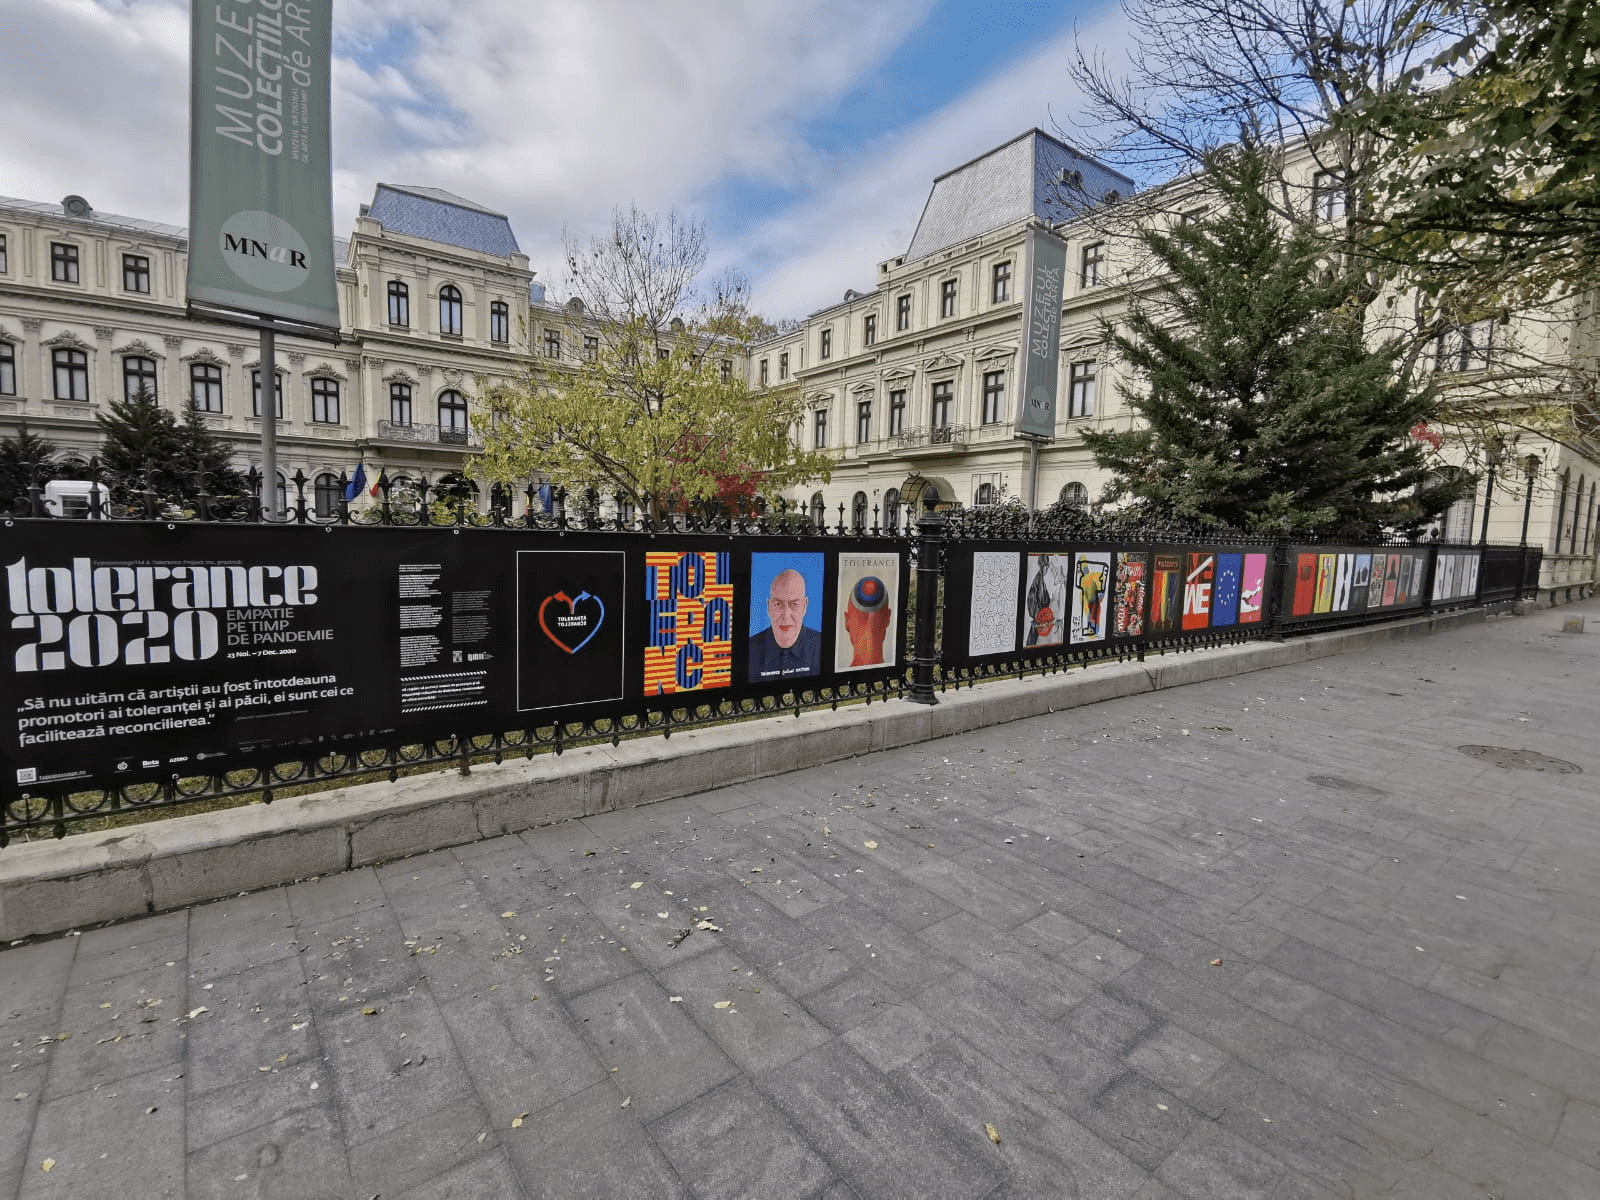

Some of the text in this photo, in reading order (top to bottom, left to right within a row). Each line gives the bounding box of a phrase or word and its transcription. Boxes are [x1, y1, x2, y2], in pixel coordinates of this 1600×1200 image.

[284, 0, 311, 87] de AR
[216, 0, 253, 146] MUZE
[224, 233, 308, 270] MNaR
[1032, 263, 1048, 356] MUZEUL
[1049, 303, 1057, 324] de
[843, 559, 895, 568] TOLERANCE
[4, 556, 318, 614] tolerance
[1183, 583, 1211, 615] WE
[226, 607, 295, 621] EMPATIE
[227, 619, 290, 634] PE TIMP
[11, 610, 219, 673] 2020
[227, 629, 335, 646] DE PANDEMIE
[49, 698, 72, 708] nu
[75, 691, 125, 706] uităm
[127, 688, 146, 701] că
[149, 684, 199, 700] artiștii
[201, 685, 221, 695] au
[223, 681, 252, 695] fost
[253, 674, 336, 690] întotdeauna
[18, 686, 355, 731] promotori ai toleranței și ai păcii, ei sunt cei ce
[18, 725, 106, 748] facilitează
